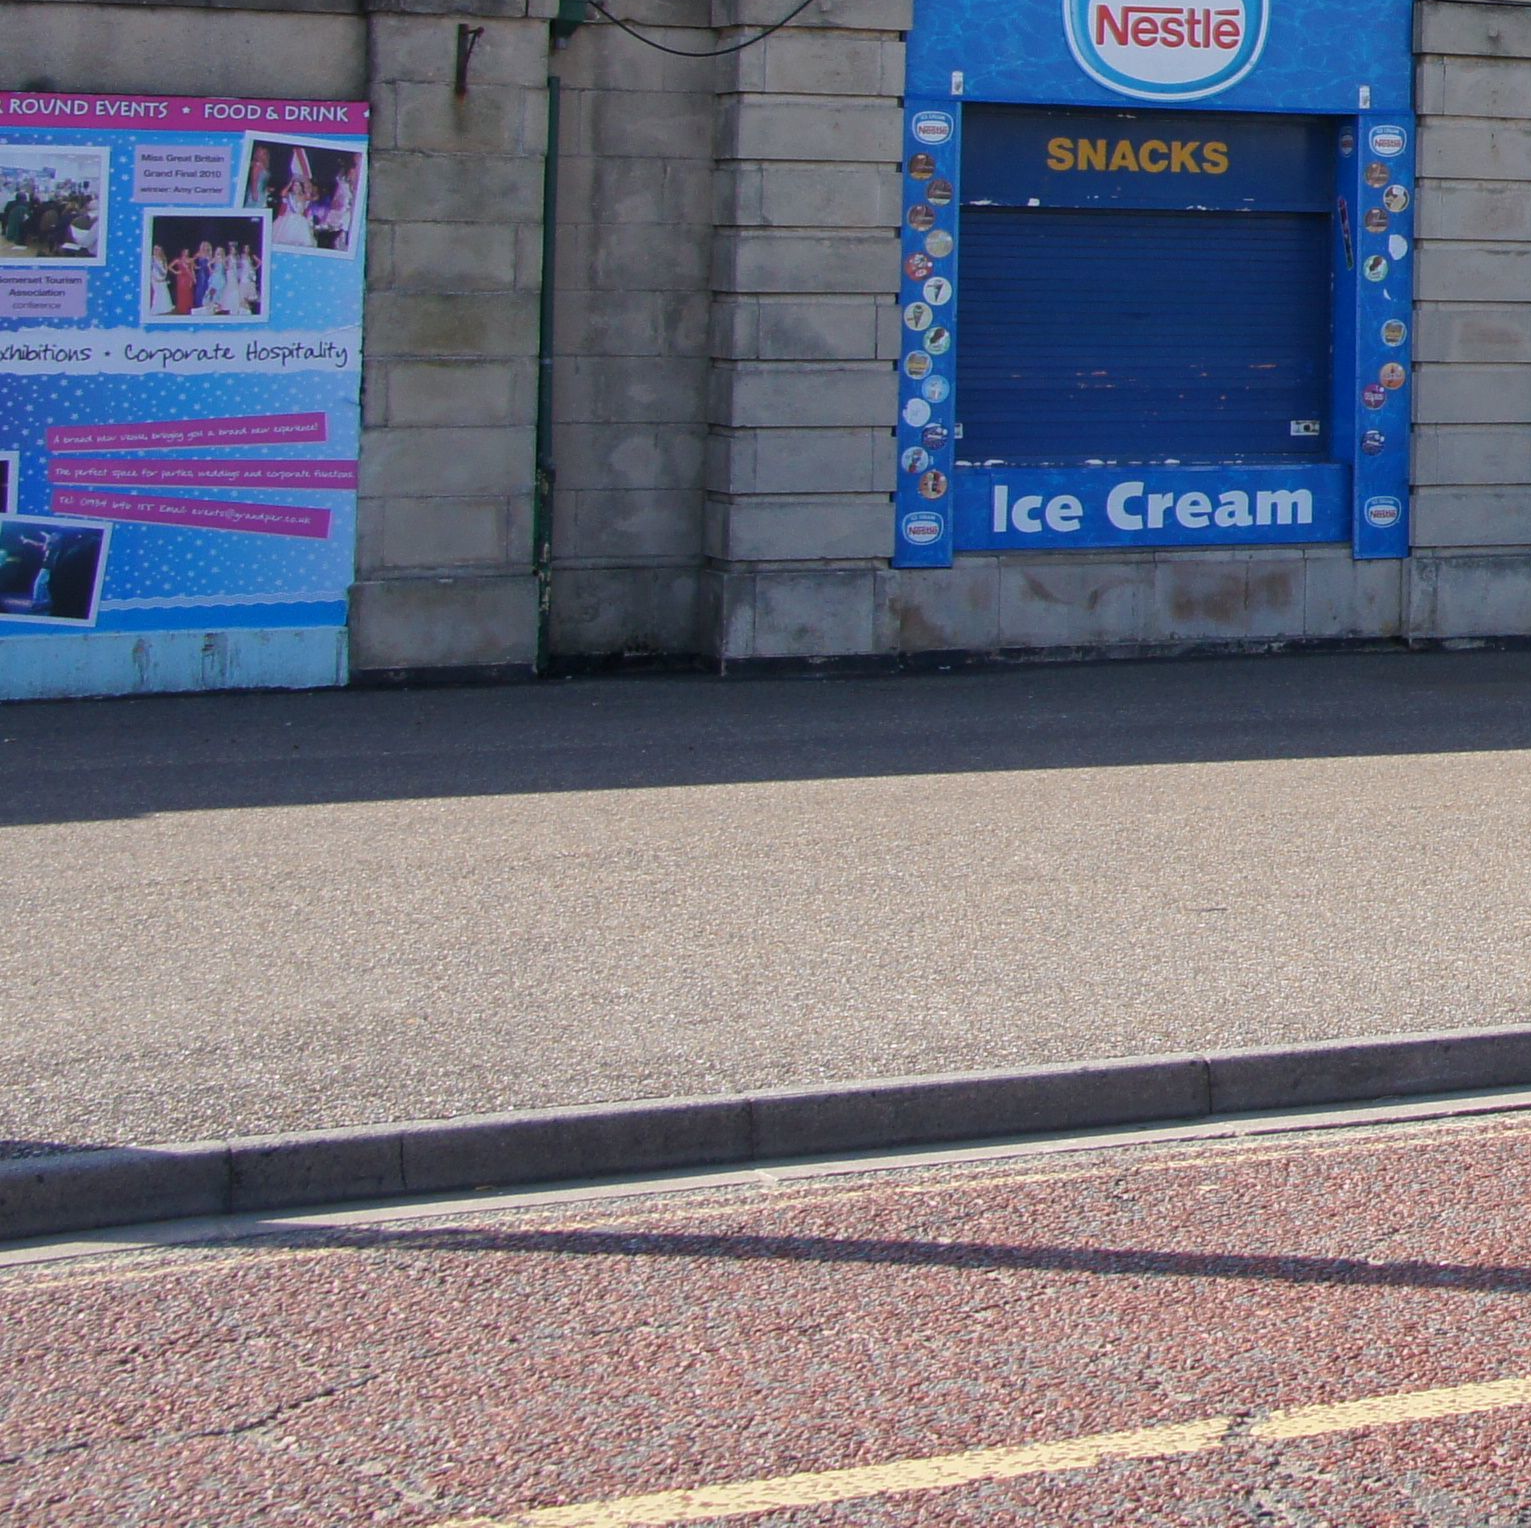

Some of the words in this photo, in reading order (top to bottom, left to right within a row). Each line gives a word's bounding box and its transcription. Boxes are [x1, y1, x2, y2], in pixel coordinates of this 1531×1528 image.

[9, 98, 88, 115] ROUND
[95, 100, 169, 119] EVENTS
[204, 103, 261, 120] FOOD
[265, 106, 279, 120] &
[284, 105, 349, 123] DRINK
[1046, 137, 1229, 174] SNACKS
[143, 169, 173, 178] Grand
[175, 169, 197, 178] Final
[199, 170, 222, 178] 2010
[0, 276, 42, 284] omerset
[0, 343, 92, 363] xhibitions
[125, 343, 235, 368] Corporate
[246, 343, 348, 368] Hospitality
[993, 484, 1083, 533] Ice
[1106, 480, 1313, 530] Cream
